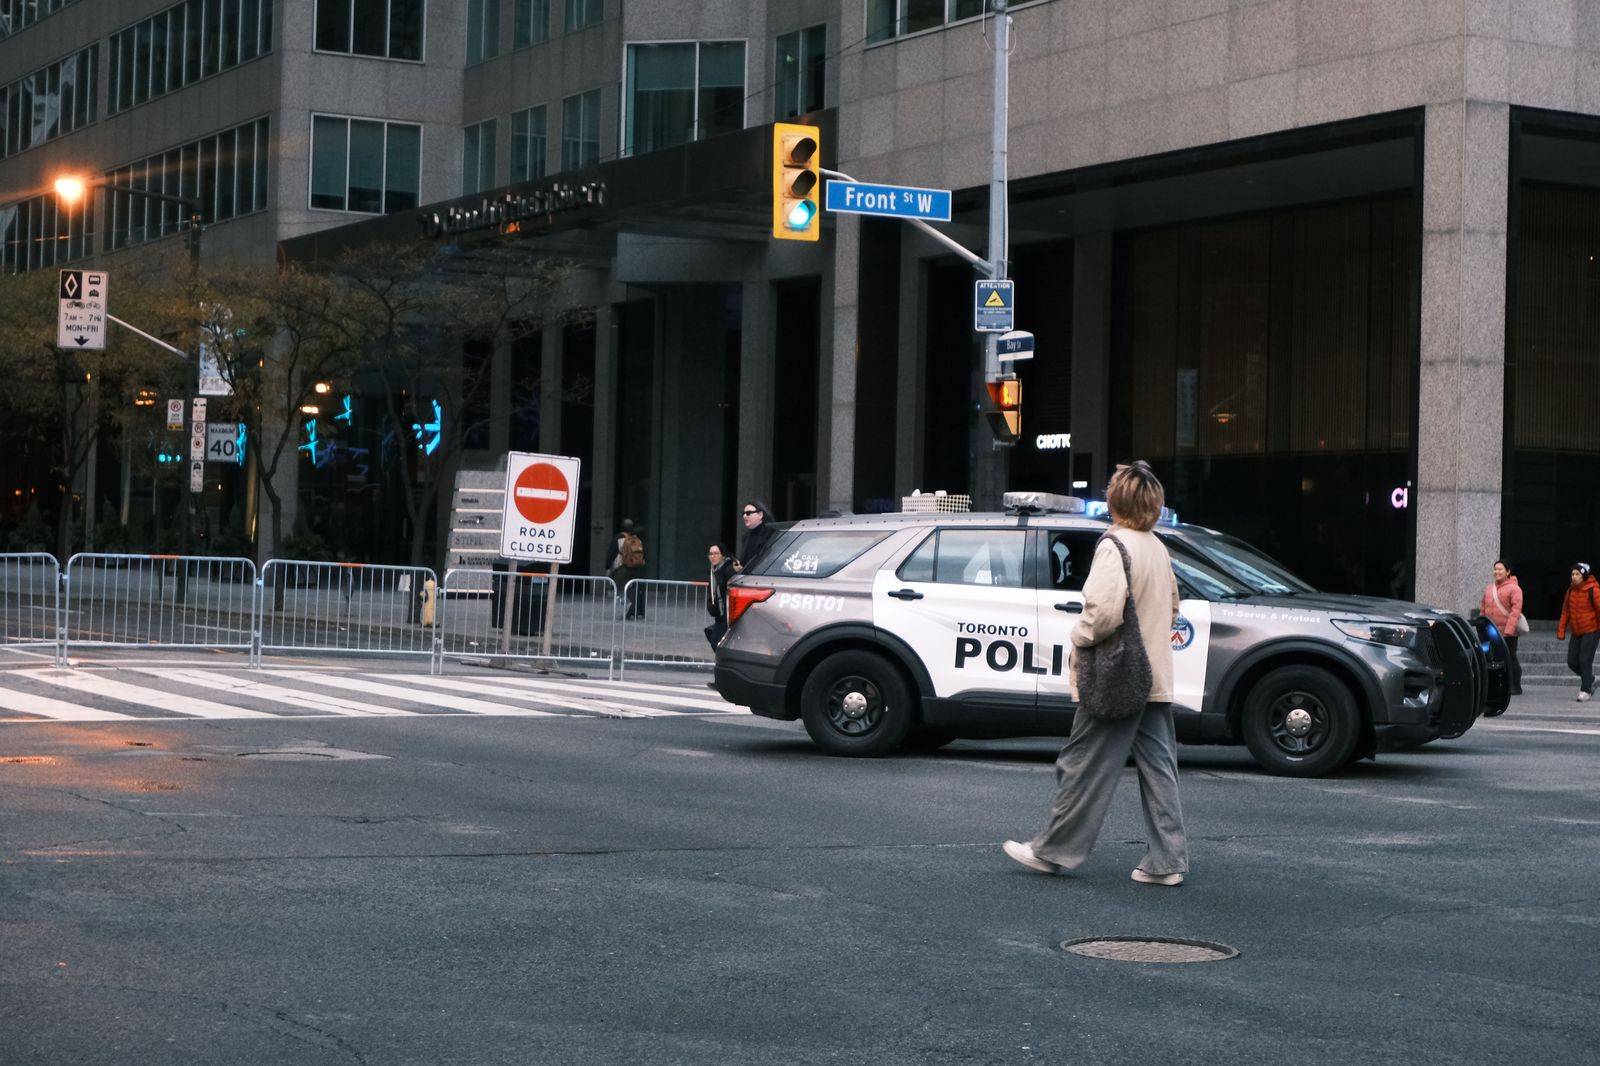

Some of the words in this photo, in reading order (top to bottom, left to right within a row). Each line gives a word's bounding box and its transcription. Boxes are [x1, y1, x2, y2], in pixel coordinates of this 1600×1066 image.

[845, 186, 896, 211] Front
[903, 191, 914, 204] St
[917, 193, 933, 213] W
[65, 324, 99, 333] MON-FRI
[1006, 339, 1016, 351] Bay
[210, 439, 235, 457] 40
[519, 526, 556, 539] ROAD
[510, 541, 562, 555] CLOSED
[792, 559, 819, 571] 911
[779, 592, 845, 612] PSRT01
[1221, 609, 1233, 617] To
[1237, 610, 1267, 619] Serve
[1270, 612, 1278, 620] &
[1281, 613, 1321, 624] Protect
[957, 622, 1028, 637] TORONTO
[954, 637, 1070, 676] POLI
